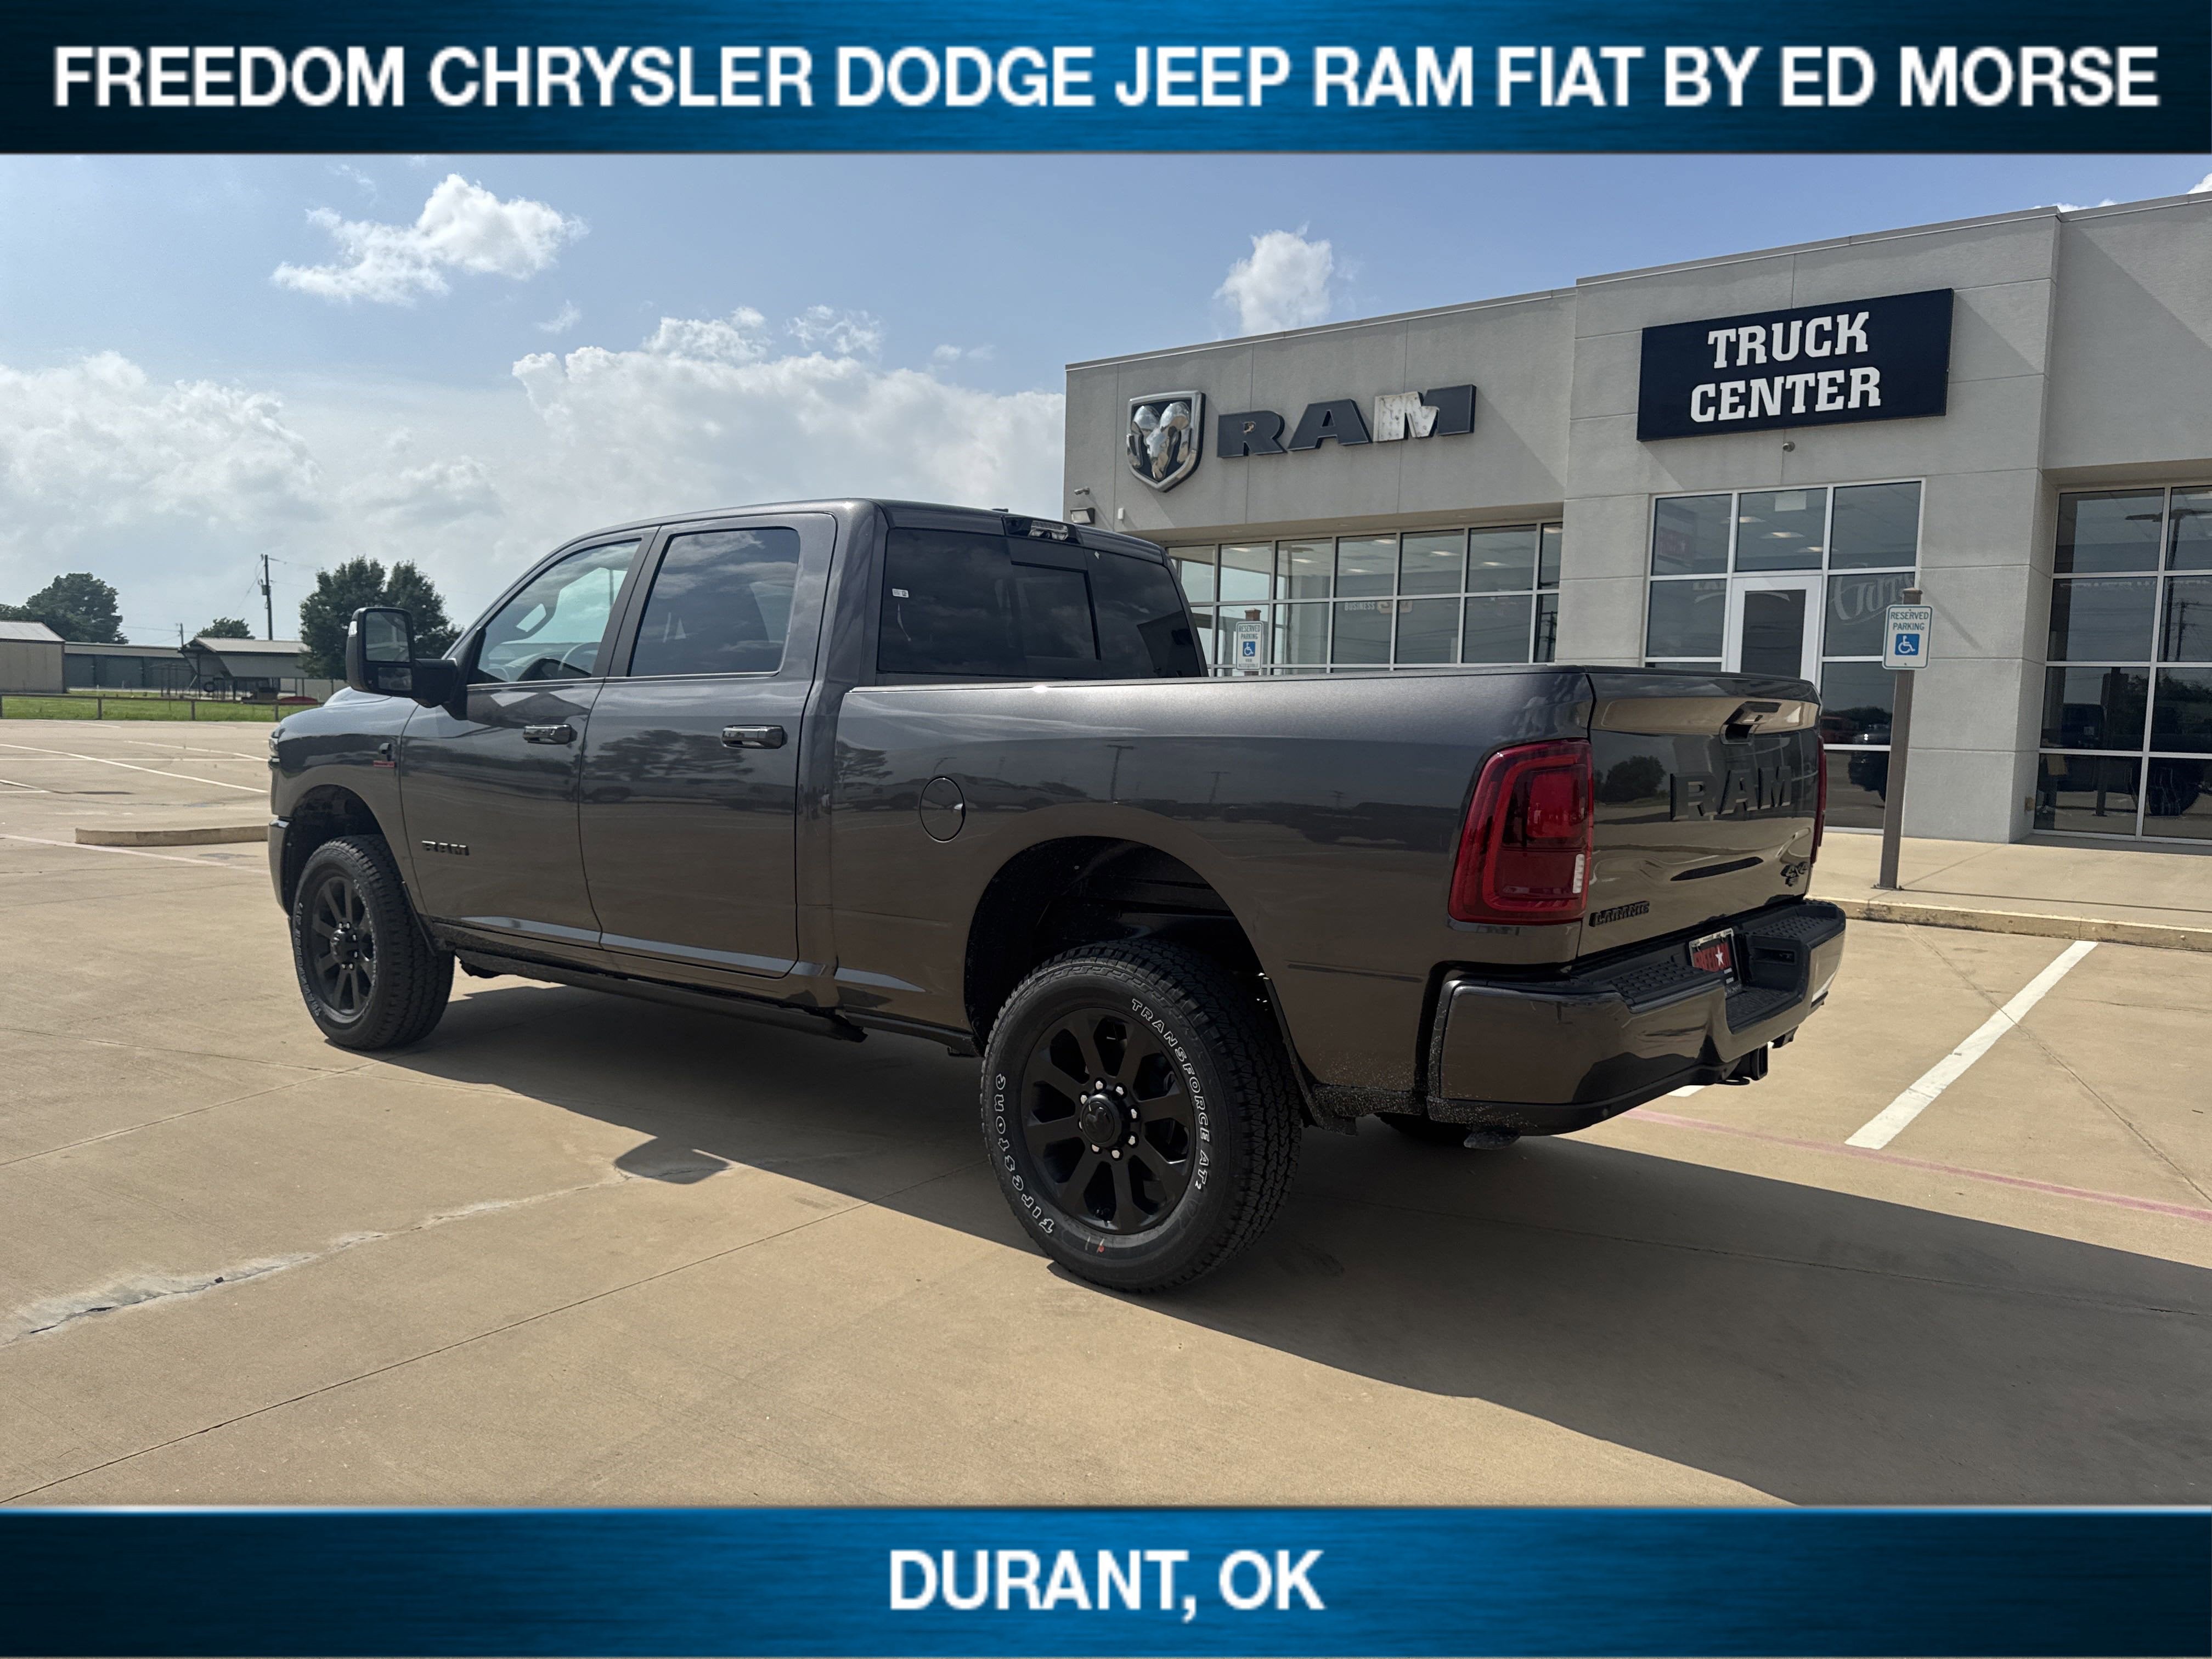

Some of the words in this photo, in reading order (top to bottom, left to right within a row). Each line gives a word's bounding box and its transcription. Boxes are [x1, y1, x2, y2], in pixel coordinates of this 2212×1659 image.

[1707, 311, 1869, 369] TRUCK
[1216, 384, 1477, 459] RAM
[1690, 366, 1881, 423] CENTER
[1890, 611, 1929, 620] RESERVED
[1893, 622, 1925, 631] PARKING
[1670, 766, 1792, 821] RAM
[421, 840, 470, 856] RAM
[1131, 998, 1210, 1143] TRANSFORCE
